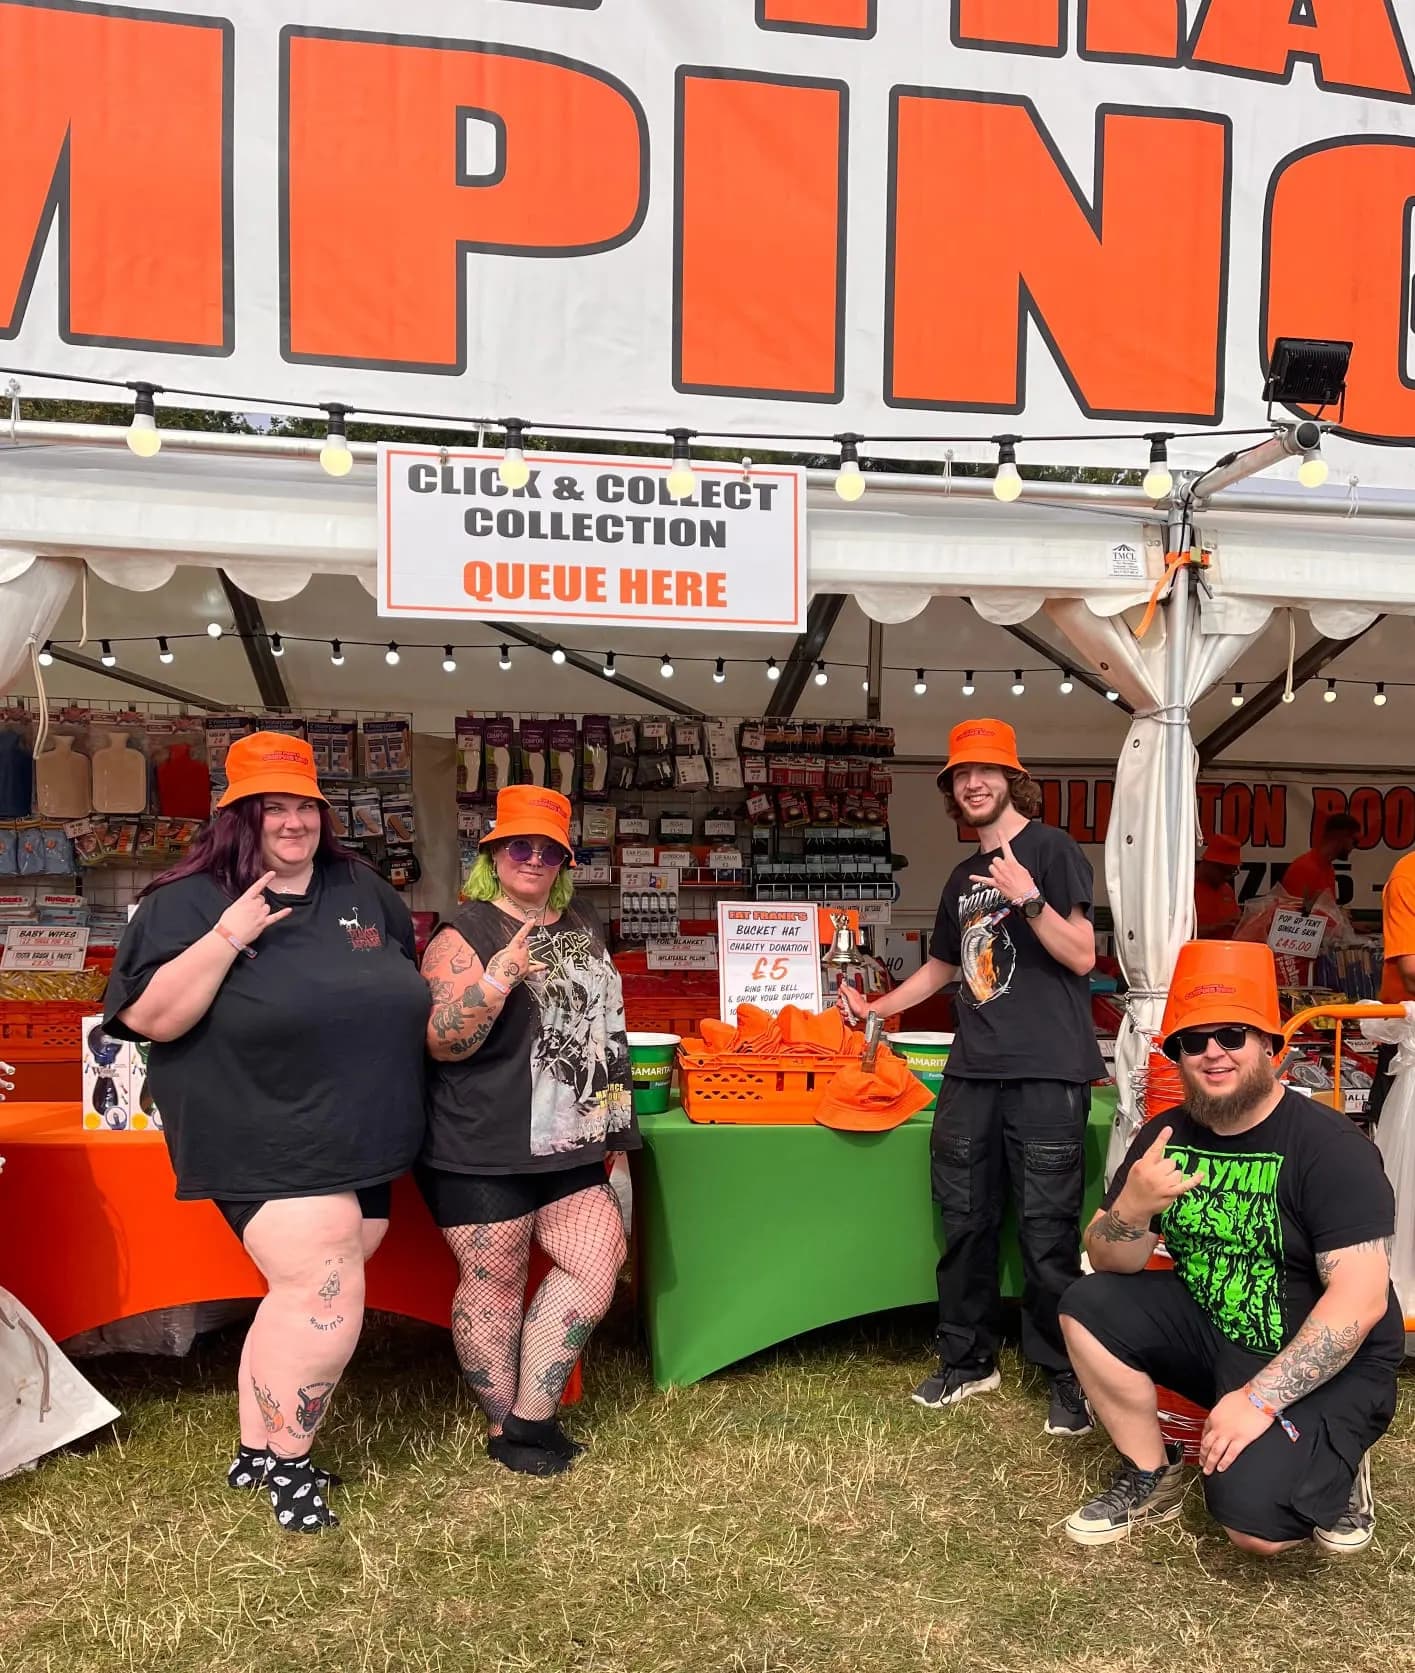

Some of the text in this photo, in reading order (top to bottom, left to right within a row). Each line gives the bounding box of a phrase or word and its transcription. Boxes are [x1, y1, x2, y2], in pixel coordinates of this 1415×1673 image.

[407, 463, 542, 499] CLICK
[552, 475, 585, 501] &
[464, 507, 727, 548] COLLECTION
[463, 561, 728, 608] QUEUE HERE
[728, 910, 808, 921] FAT FRANK'S
[1305, 919, 1322, 928] TENT
[736, 925, 801, 937] BUCKET HAT
[1277, 925, 1317, 937] SINGLE SKIN
[729, 942, 809, 952] CHARITY DONATION
[1275, 938, 1312, 952] £45.00
[752, 956, 790, 981] £5
[744, 985, 761, 993] RING
[780, 984, 798, 992] BELL
[736, 995, 757, 1003] SHOW
[760, 994, 779, 1002] YOUR
[781, 992, 814, 1001] SUPPORT
